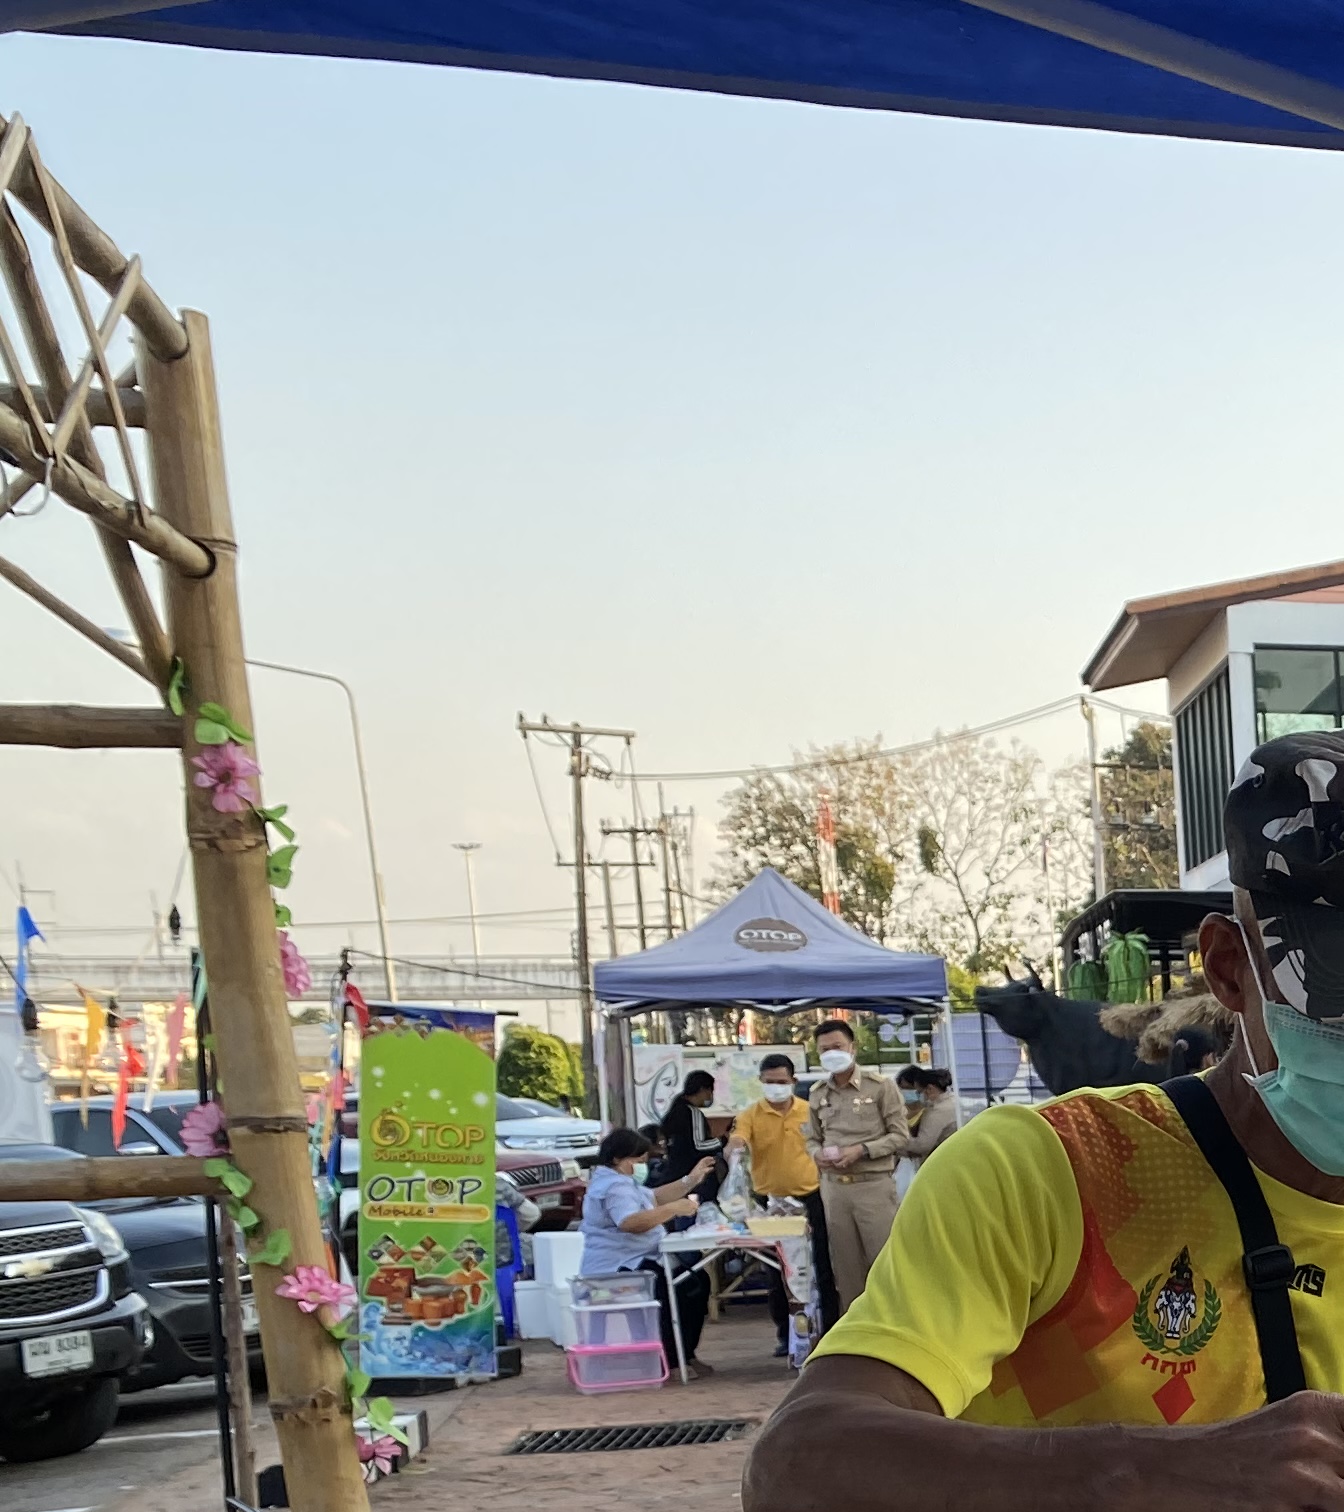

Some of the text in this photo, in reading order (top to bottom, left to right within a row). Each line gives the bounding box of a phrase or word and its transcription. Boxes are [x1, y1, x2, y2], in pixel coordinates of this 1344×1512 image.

[738, 928, 802, 941] OTOP
[370, 1112, 485, 1150] OTOP
[368, 1176, 482, 1205] OTOP
[368, 1205, 423, 1217] Mobile
